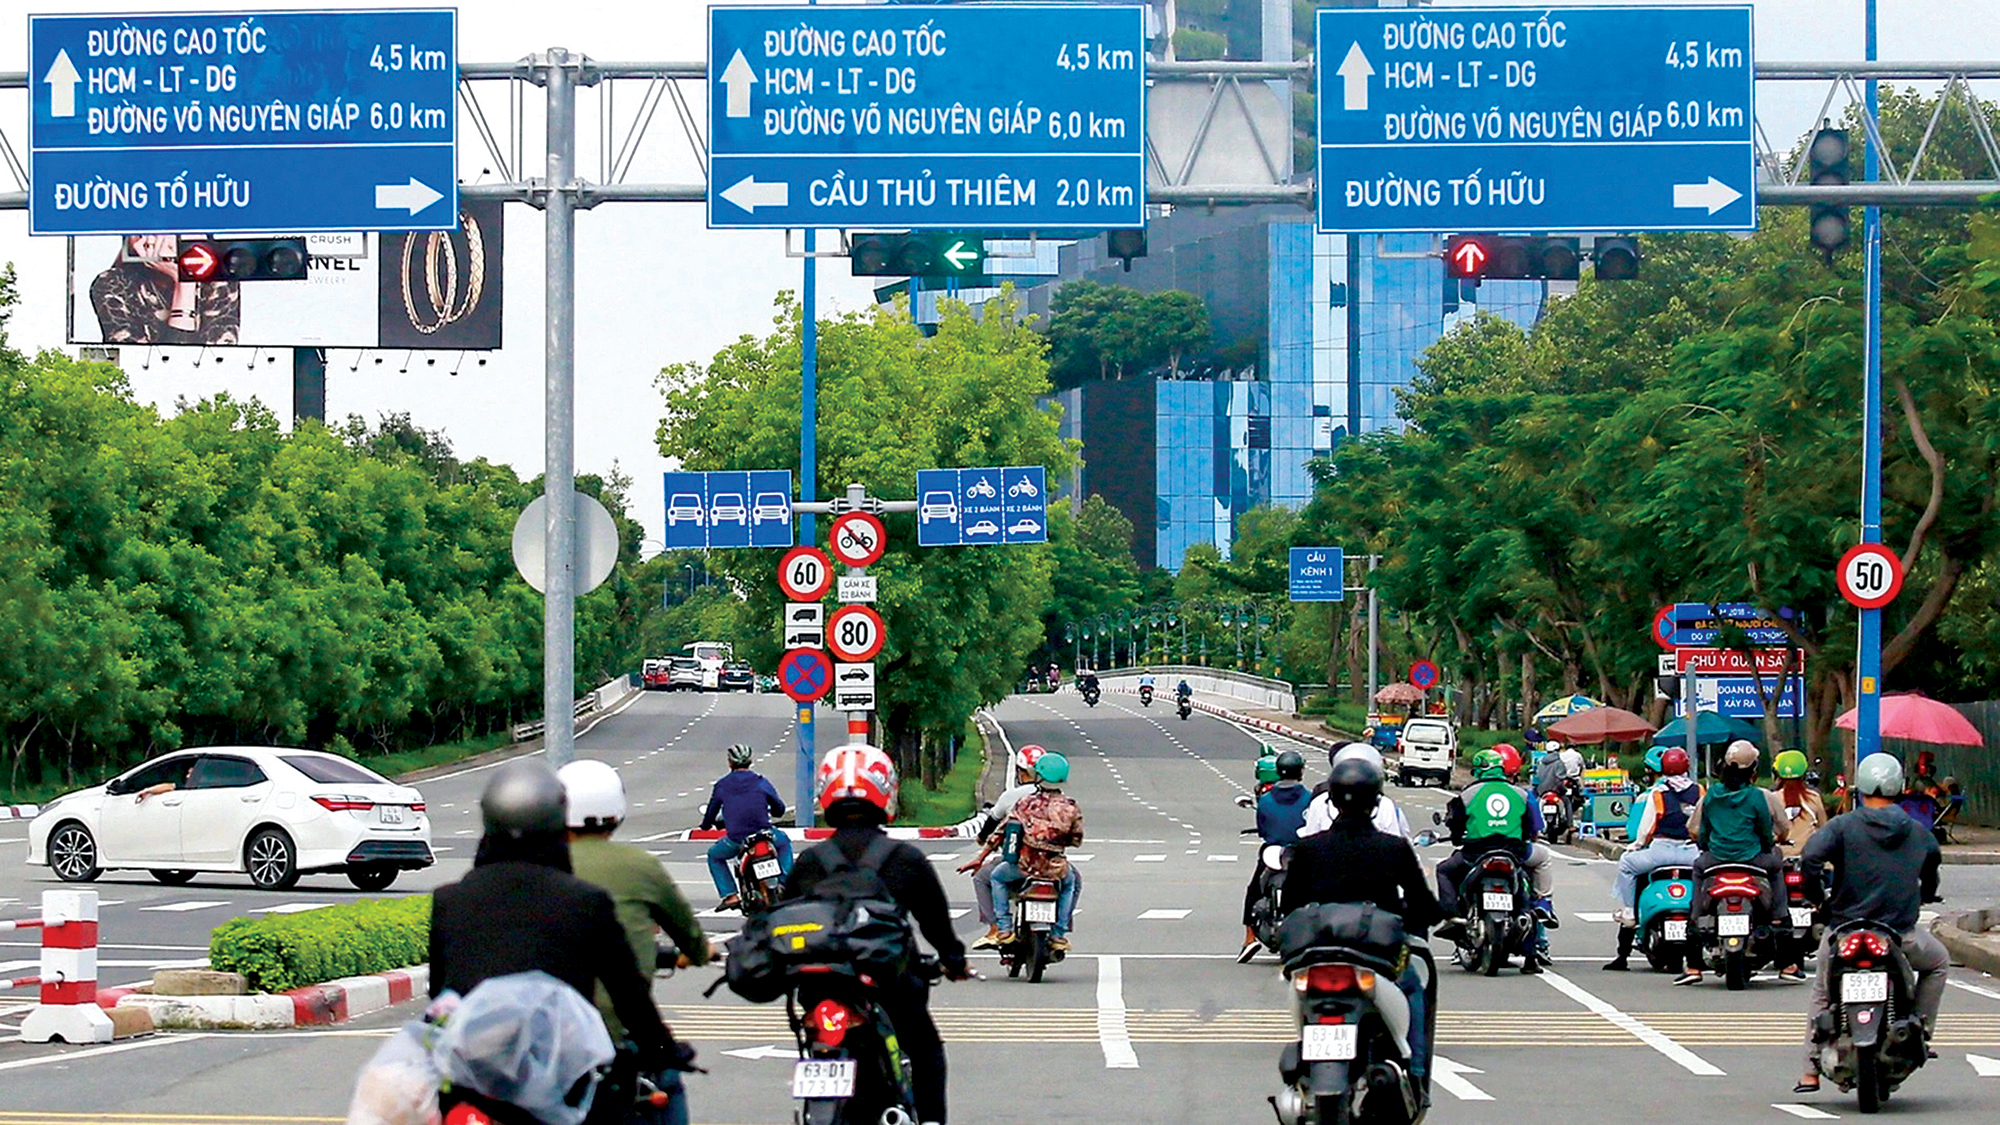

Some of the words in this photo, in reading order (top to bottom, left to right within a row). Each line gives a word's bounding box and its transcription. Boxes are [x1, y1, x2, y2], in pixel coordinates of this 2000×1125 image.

[88, 22, 166, 56] ĐƯỜNG
[174, 28, 216, 54] CAO
[223, 18, 265, 54] TỐC
[764, 22, 845, 56] ĐƯỜNG
[853, 30, 895, 56] CAO
[902, 19, 945, 56] TỐC
[1384, 15, 1464, 49] ĐƯỜNG
[1473, 23, 1515, 48] CAO
[1522, 12, 1566, 47] TỐC
[370, 45, 402, 71] 4,5
[411, 45, 445, 70] km
[1057, 44, 1089, 71] 4,5
[1098, 44, 1133, 69] km
[1666, 42, 1698, 69] 4,5
[1707, 42, 1741, 67] km
[89, 67, 135, 94] HCM
[160, 66, 184, 92] LT
[207, 65, 236, 91] DG
[766, 68, 813, 94] HCM
[838, 68, 862, 94] LT
[886, 68, 915, 93] DG
[1386, 62, 1433, 88] HCM
[1459, 61, 1482, 87] LT
[1506, 61, 1535, 87] DG
[88, 101, 167, 134] ĐƯỜNG
[174, 101, 202, 132] VÕ
[210, 100, 299, 131] NGUYÊN
[308, 97, 359, 129] GIÁP
[371, 103, 402, 129] 6,0
[411, 103, 445, 128] km
[764, 98, 845, 135] ĐƯỜNG
[852, 102, 880, 134] VÕ
[889, 102, 980, 134] NGUYÊN
[989, 101, 1041, 133] GIÁP
[1049, 112, 1081, 139] 6,0
[1090, 112, 1124, 137] km
[1385, 103, 1465, 140] ĐƯỜNG
[1473, 107, 1501, 138] VÕ
[1510, 106, 1601, 138] NGUYÊN
[1610, 105, 1662, 137] GIÁP
[1667, 101, 1699, 128] 6,0
[1708, 101, 1742, 126] km
[55, 176, 147, 209] ĐƯỜNG
[155, 171, 187, 208] TỐ
[195, 174, 249, 207] HỮU
[810, 170, 867, 205] CẦU
[877, 169, 935, 205] THỦ
[944, 174, 1035, 205] THIÊM
[1057, 179, 1089, 206] 2,0
[1098, 180, 1132, 205] km
[1346, 172, 1440, 206] ĐƯỜNG
[1449, 168, 1481, 205] TỐ
[1489, 172, 1544, 205] HỮU
[310, 235, 352, 245] CRUSH
[794, 562, 816, 585] 60
[1855, 562, 1883, 590] 50
[841, 621, 868, 646] 80
[1692, 651, 1716, 667] CHÚ
[1720, 651, 1727, 667] Ý
[1731, 656, 1764, 667] QUN
[1768, 651, 1786, 667] SÁ
[1743, 699, 1756, 707] RA
[1850, 975, 1880, 987] 59-P2
